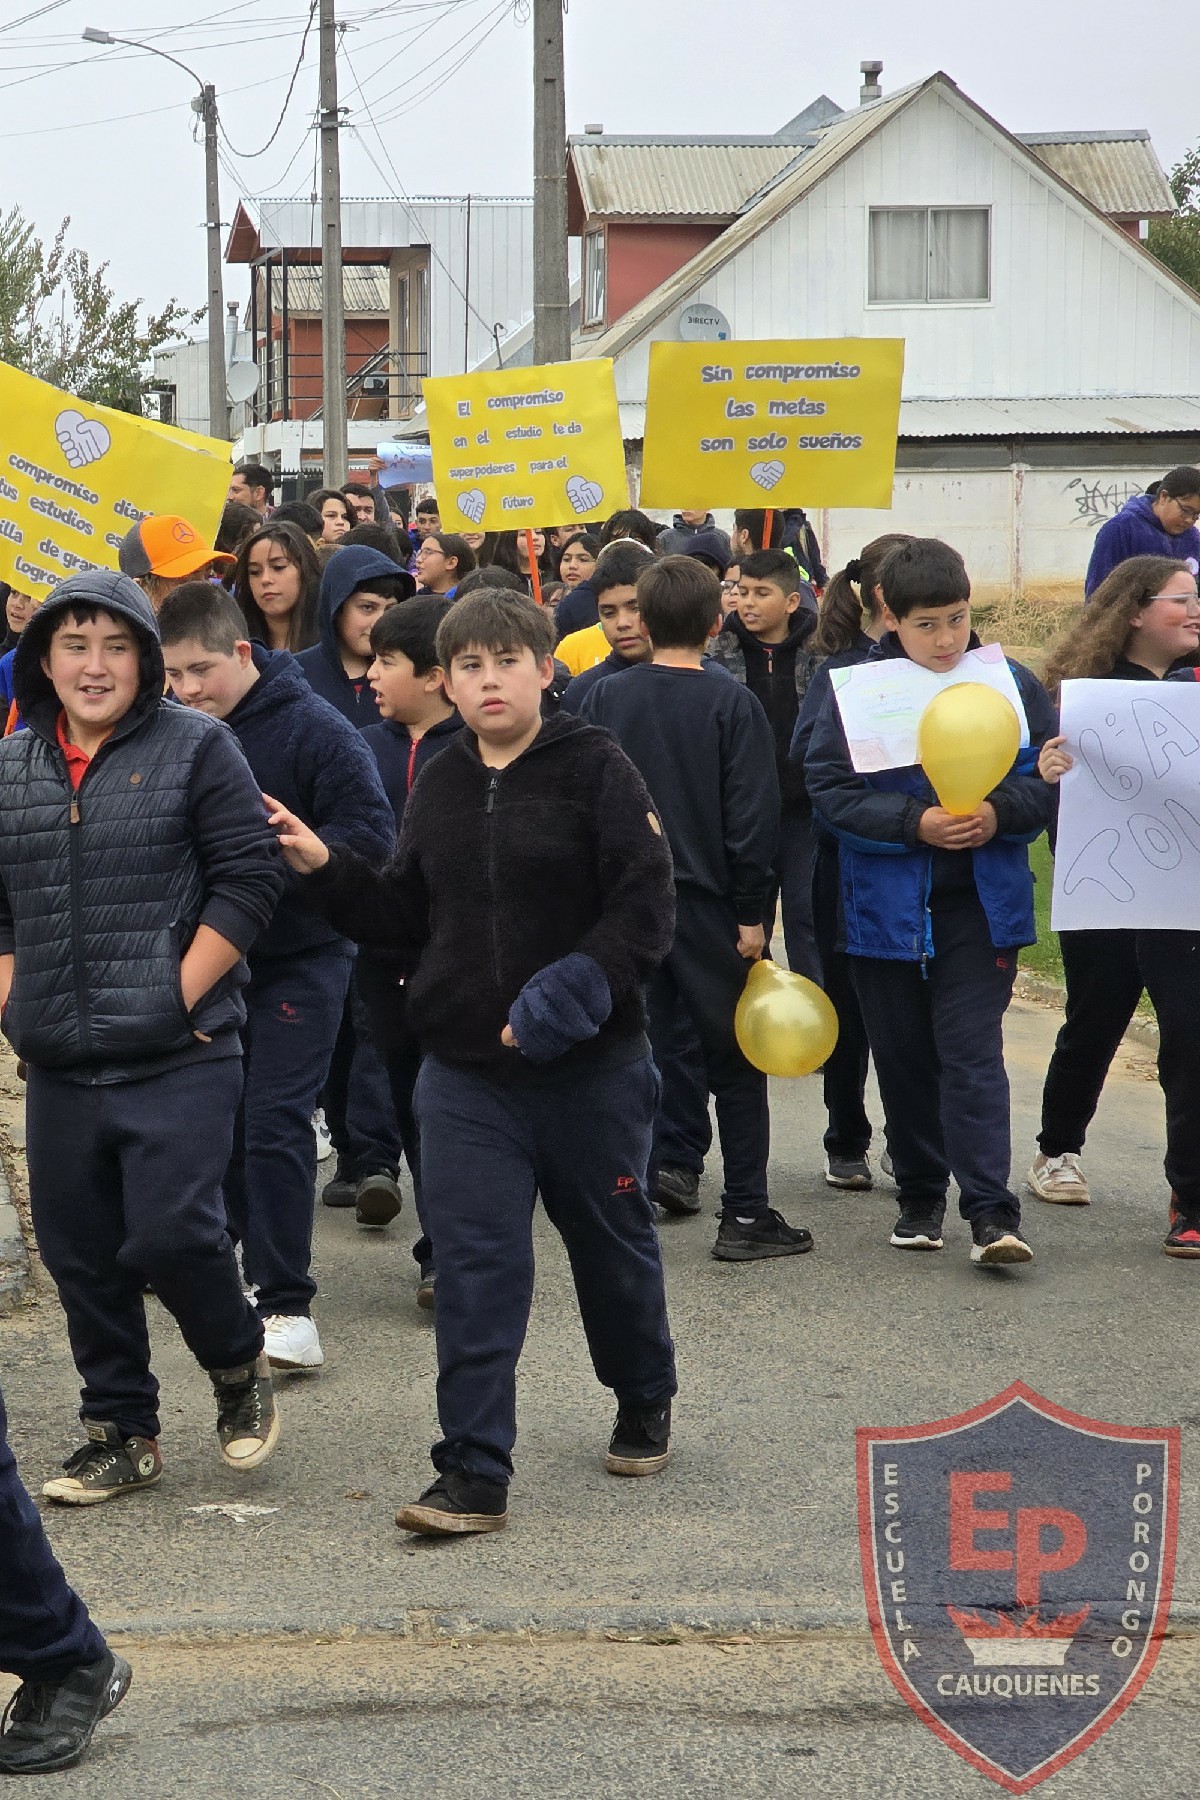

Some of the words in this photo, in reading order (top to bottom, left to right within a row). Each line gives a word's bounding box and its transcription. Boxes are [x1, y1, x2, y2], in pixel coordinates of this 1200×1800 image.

[688, 316, 720, 325] DIRECTV
[701, 364, 733, 383] Sin
[745, 361, 861, 384] compromiso
[458, 402, 471, 416] El
[487, 390, 564, 410] compromiso
[768, 397, 826, 416] metas
[453, 437, 468, 448] en
[477, 430, 490, 444] el
[505, 426, 542, 439] estudio
[552, 423, 565, 435] te
[567, 421, 582, 434] da
[700, 438, 734, 452] son
[747, 432, 788, 451] solo
[798, 432, 863, 449] sueños
[530, 460, 554, 474] para
[556, 456, 568, 468] el
[8, 454, 99, 505] compromiso
[30, 496, 93, 536] estudios
[39, 539, 60, 558] de
[63, 552, 110, 572] gran
